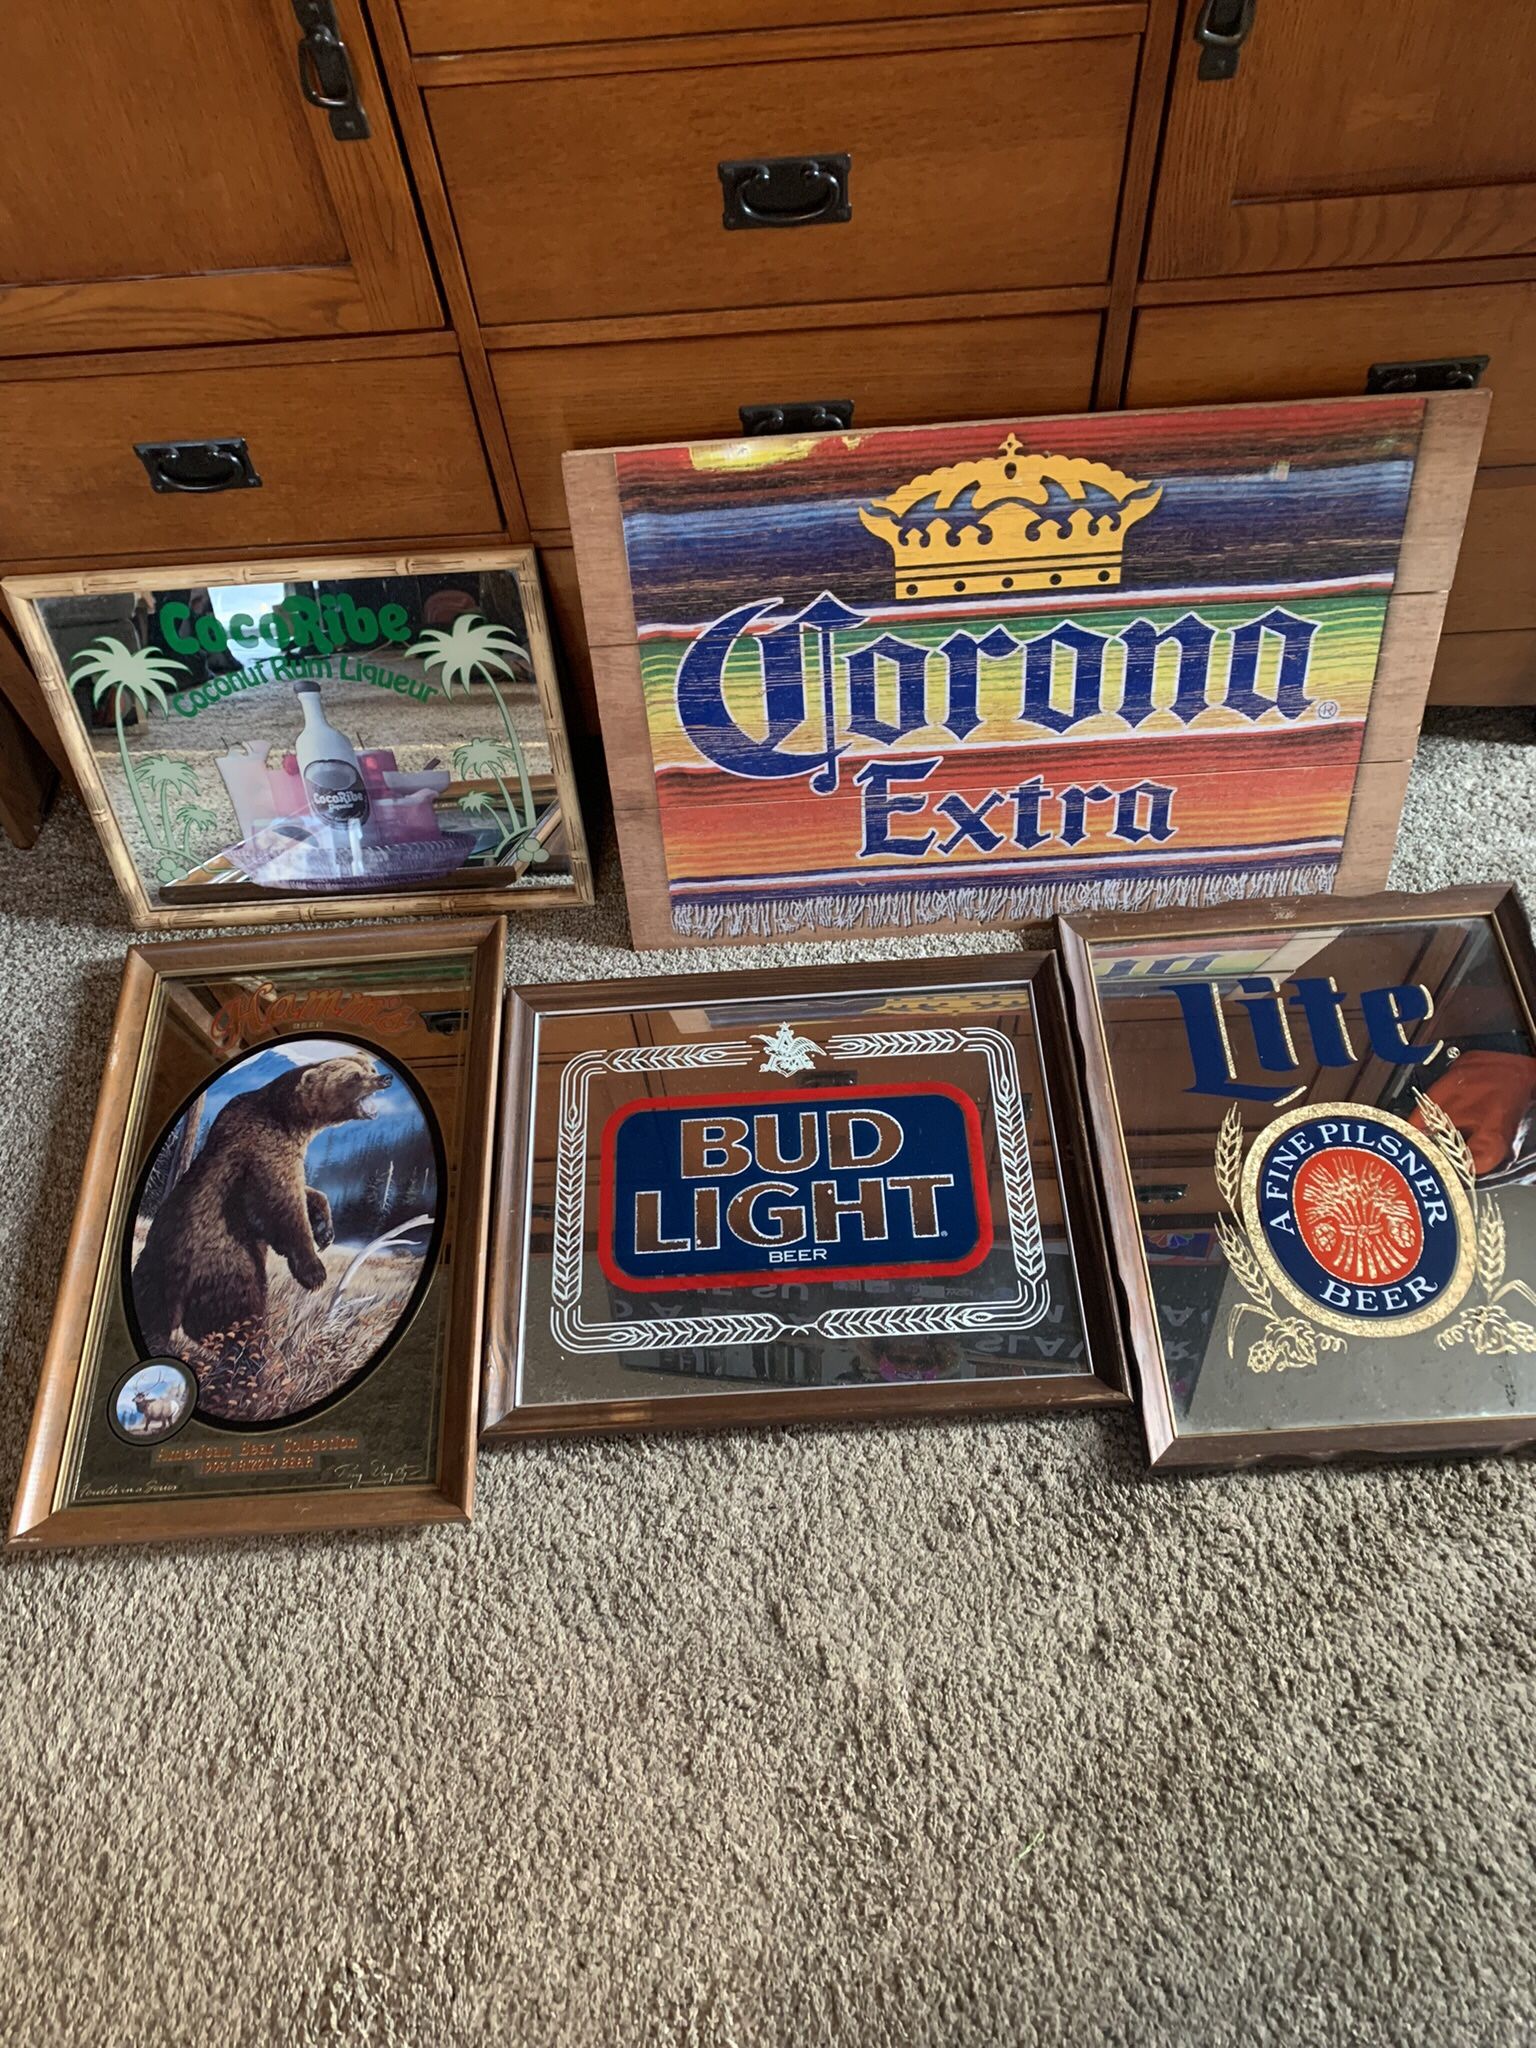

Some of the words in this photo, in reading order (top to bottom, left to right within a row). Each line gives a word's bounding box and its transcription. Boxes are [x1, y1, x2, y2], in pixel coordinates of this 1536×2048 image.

[159, 593, 412, 655] CocoRibe
[172, 660, 269, 718] Coconut
[271, 655, 333, 682] Rum
[340, 655, 439, 704] Liqueur
[676, 590, 1319, 794] Corona
[857, 756, 1180, 861] Extra
[1158, 976, 1445, 1107] Lite
[680, 1108, 905, 1179] BUD
[1266, 1132, 1314, 1201] FINE
[1317, 1123, 1448, 1228] PILSNER
[634, 1175, 954, 1255] LIGHT
[1270, 1209, 1296, 1236] A
[768, 1247, 828, 1263] BEER
[1319, 1275, 1439, 1312] BEER
[156, 1445, 233, 1463] American
[239, 1441, 275, 1458] Bear
[284, 1435, 359, 1454] Collection
[280, 1455, 313, 1469] BEAR
